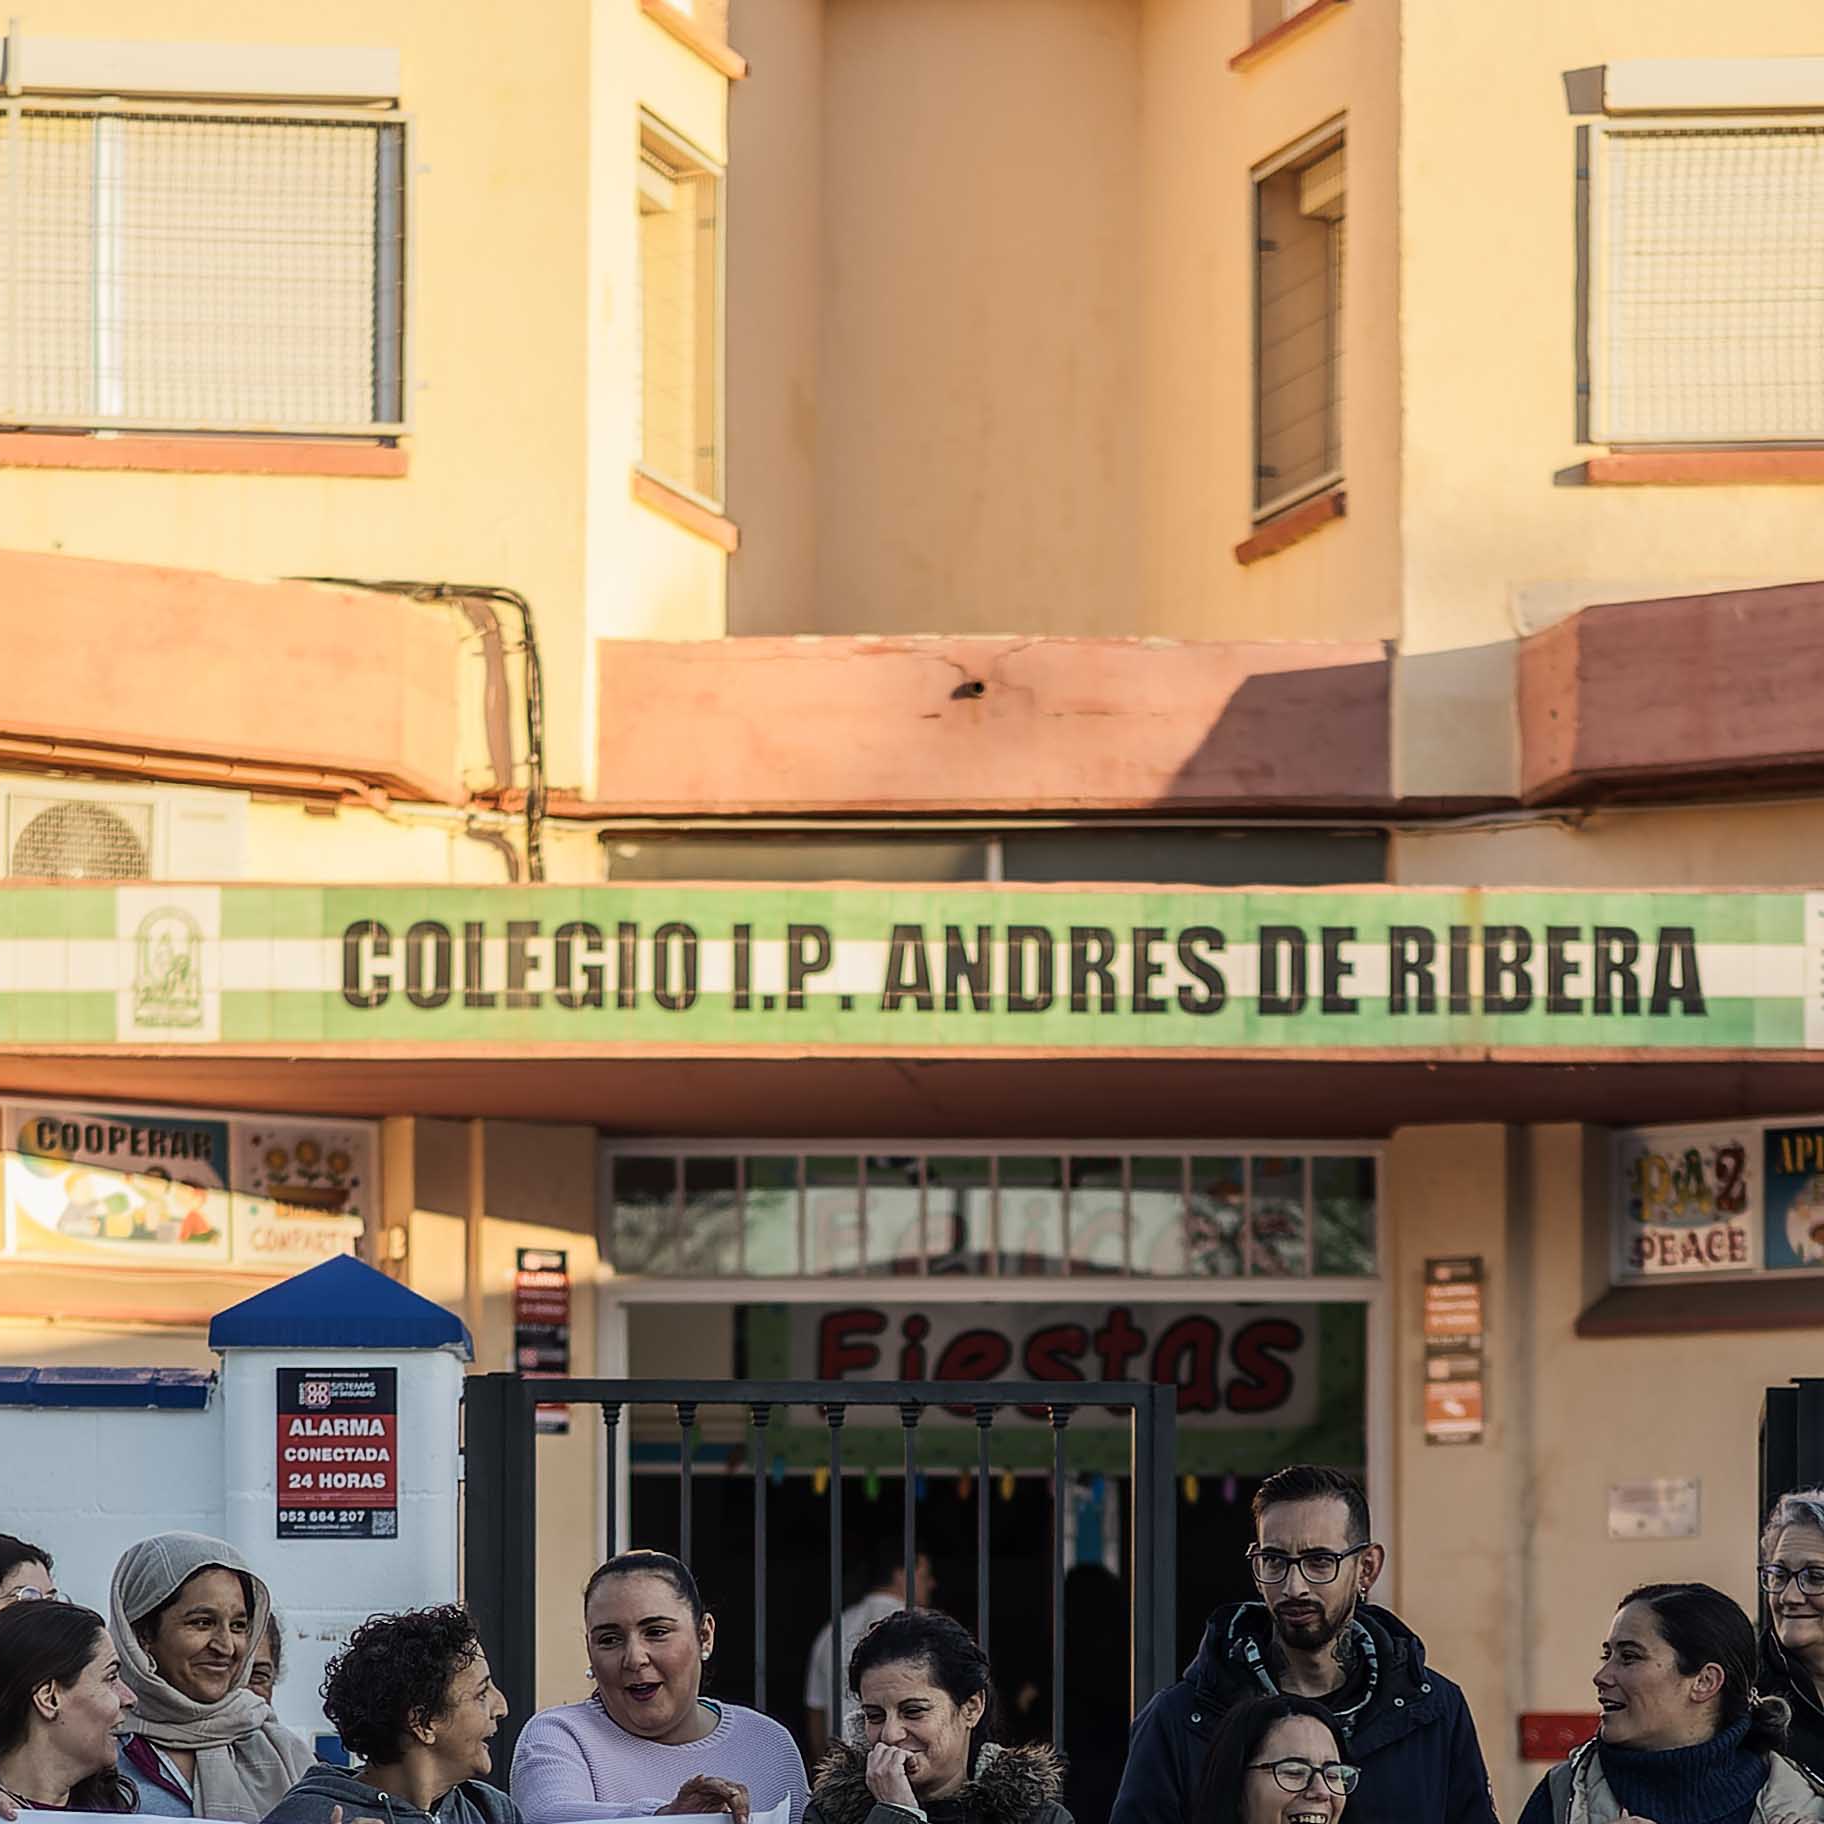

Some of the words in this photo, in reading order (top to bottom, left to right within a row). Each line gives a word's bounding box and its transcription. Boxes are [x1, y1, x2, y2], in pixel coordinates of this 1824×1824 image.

[342, 918, 701, 1011] COLEGIO
[880, 922, 1226, 1016] ANDRES
[1258, 924, 1360, 1017] DE
[1389, 924, 1709, 1018] RIBERA
[35, 1116, 213, 1161] COOPERAR
[1632, 1225, 1748, 1271] PEACE
[816, 1304, 1304, 1415] Fiestas
[289, 1418, 386, 1437] ALARMA
[284, 1447, 390, 1463] CONECTADA
[288, 1472, 314, 1489] 24
[318, 1472, 386, 1489] HORAS
[339, 1510, 366, 1523] 207
